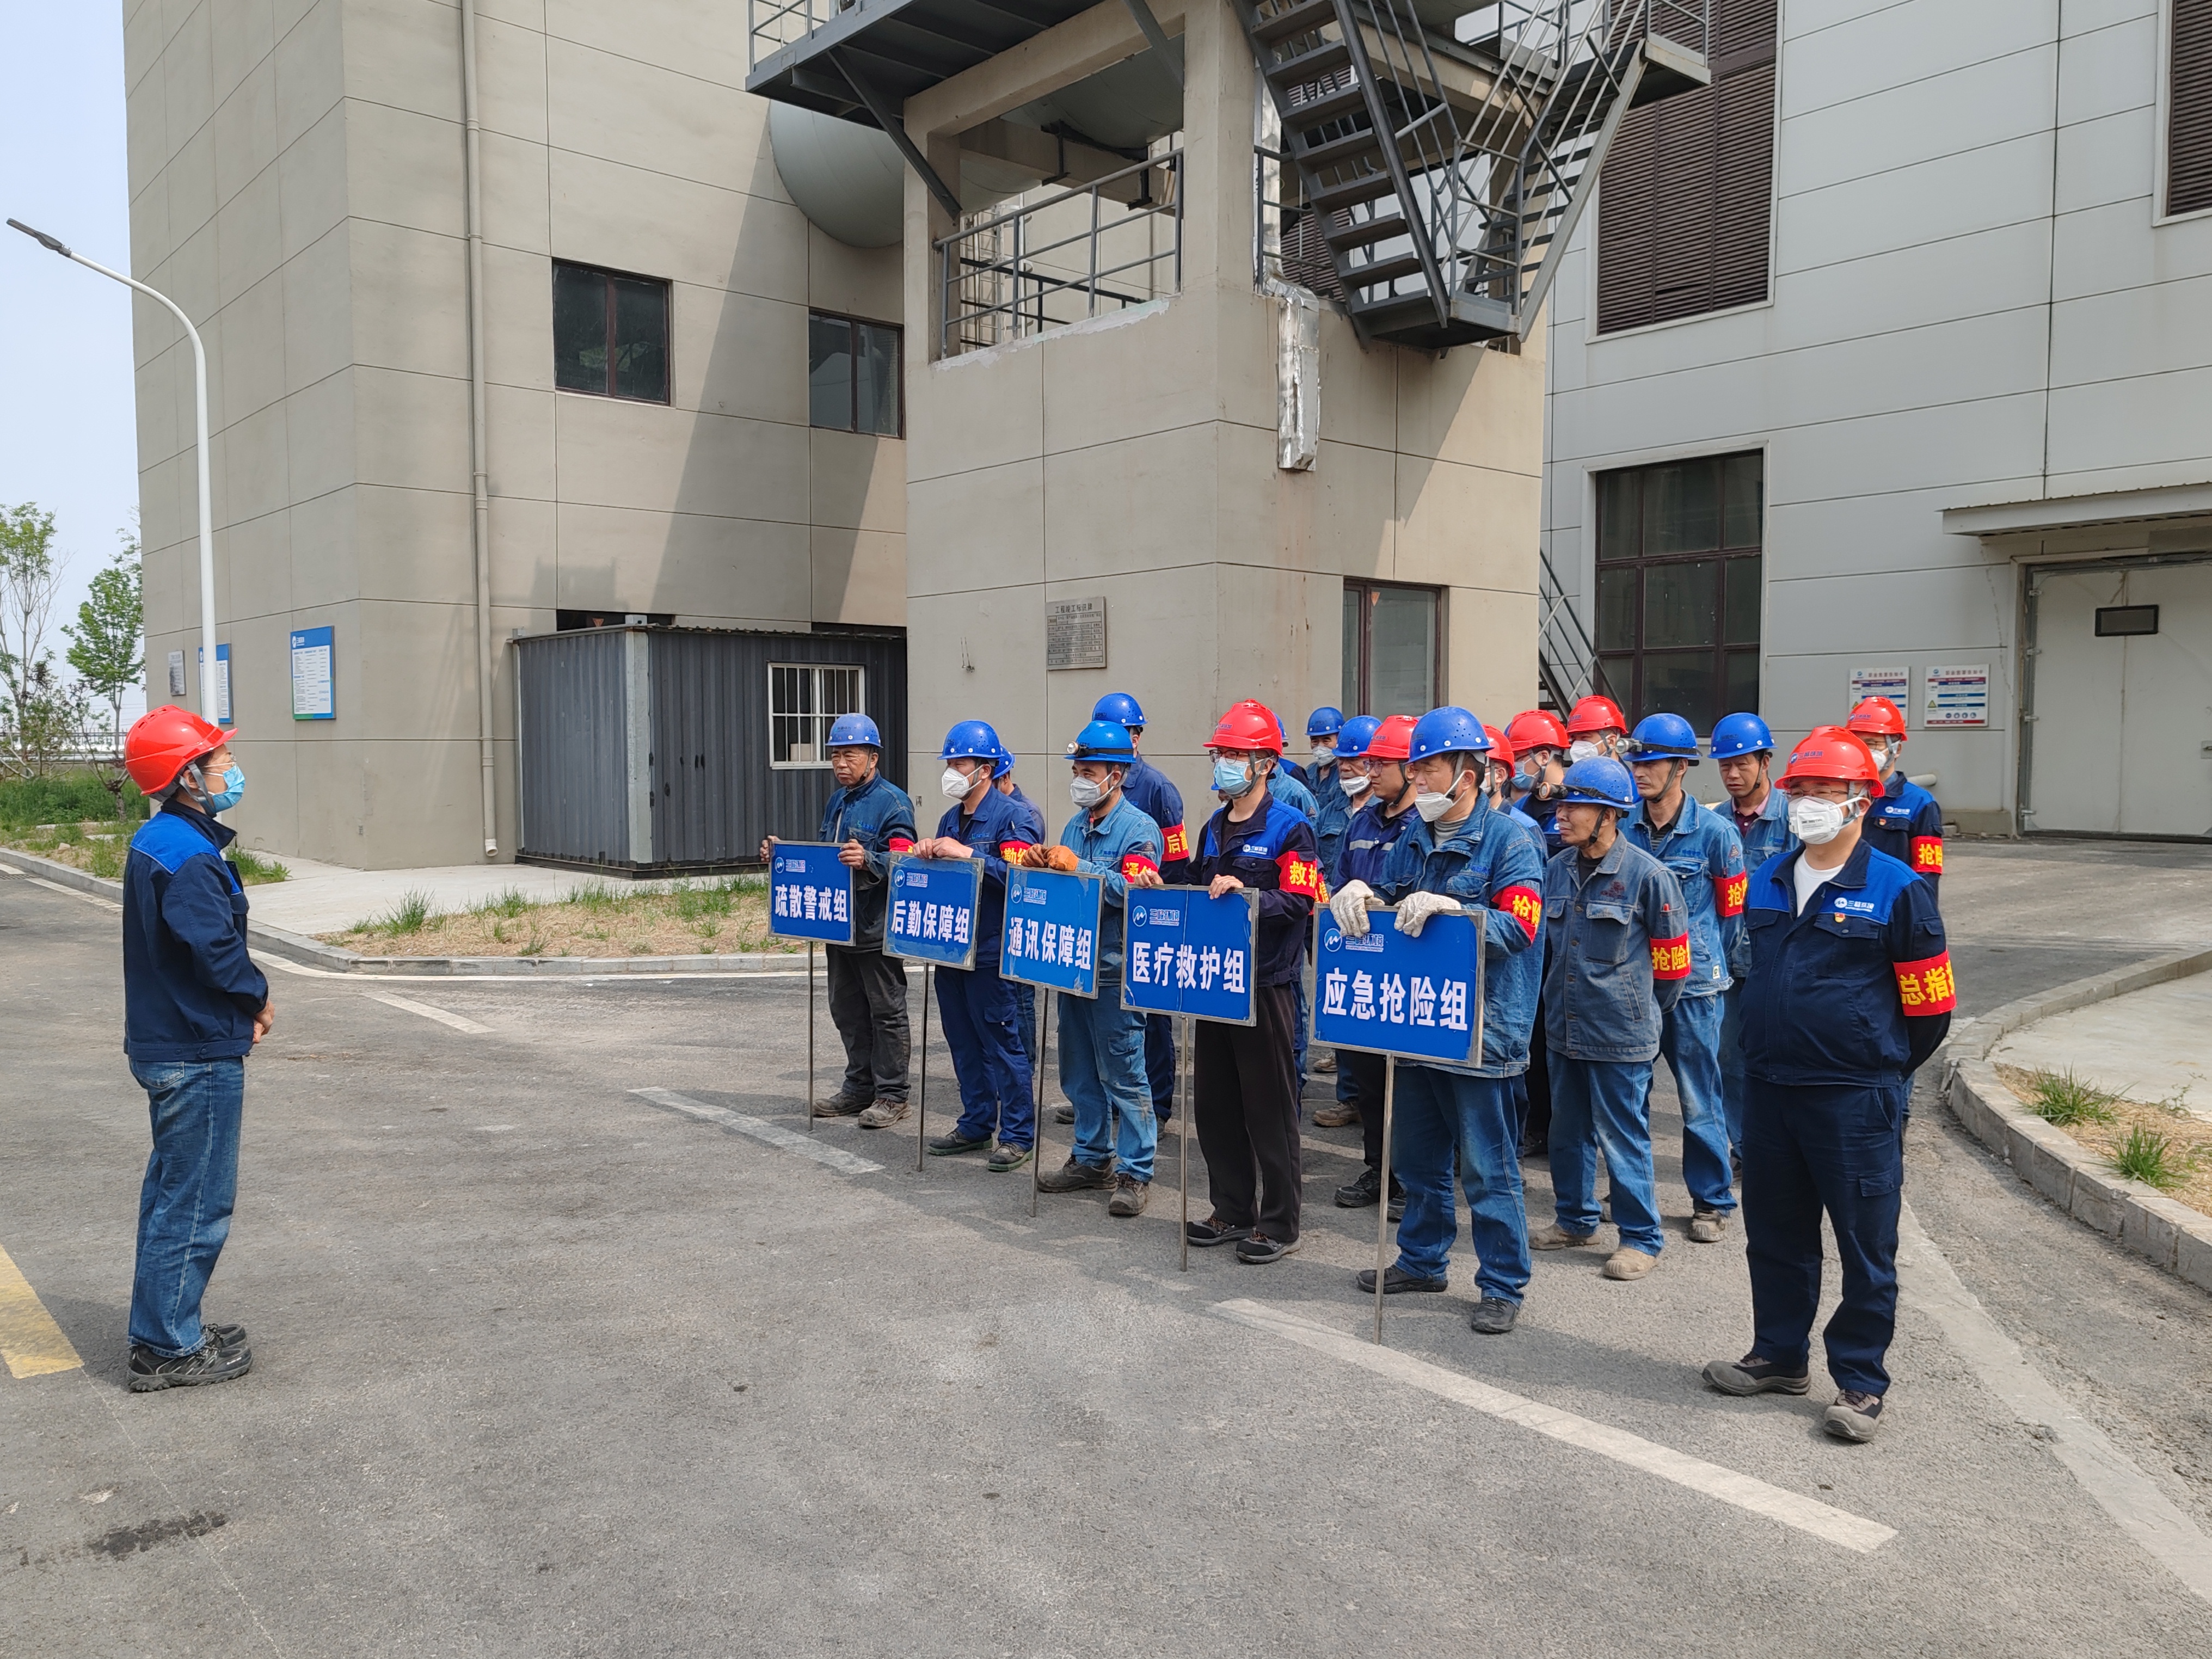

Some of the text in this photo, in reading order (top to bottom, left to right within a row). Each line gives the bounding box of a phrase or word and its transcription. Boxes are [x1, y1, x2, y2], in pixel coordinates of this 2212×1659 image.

[775, 884, 848, 923] 疏散警戒组
[891, 900, 971, 944] 后勤保障组
[1007, 917, 1092, 970] 通讯保障组
[1132, 941, 1245, 994] 医疗救护组
[1323, 967, 1468, 1031] 应急抢险组
